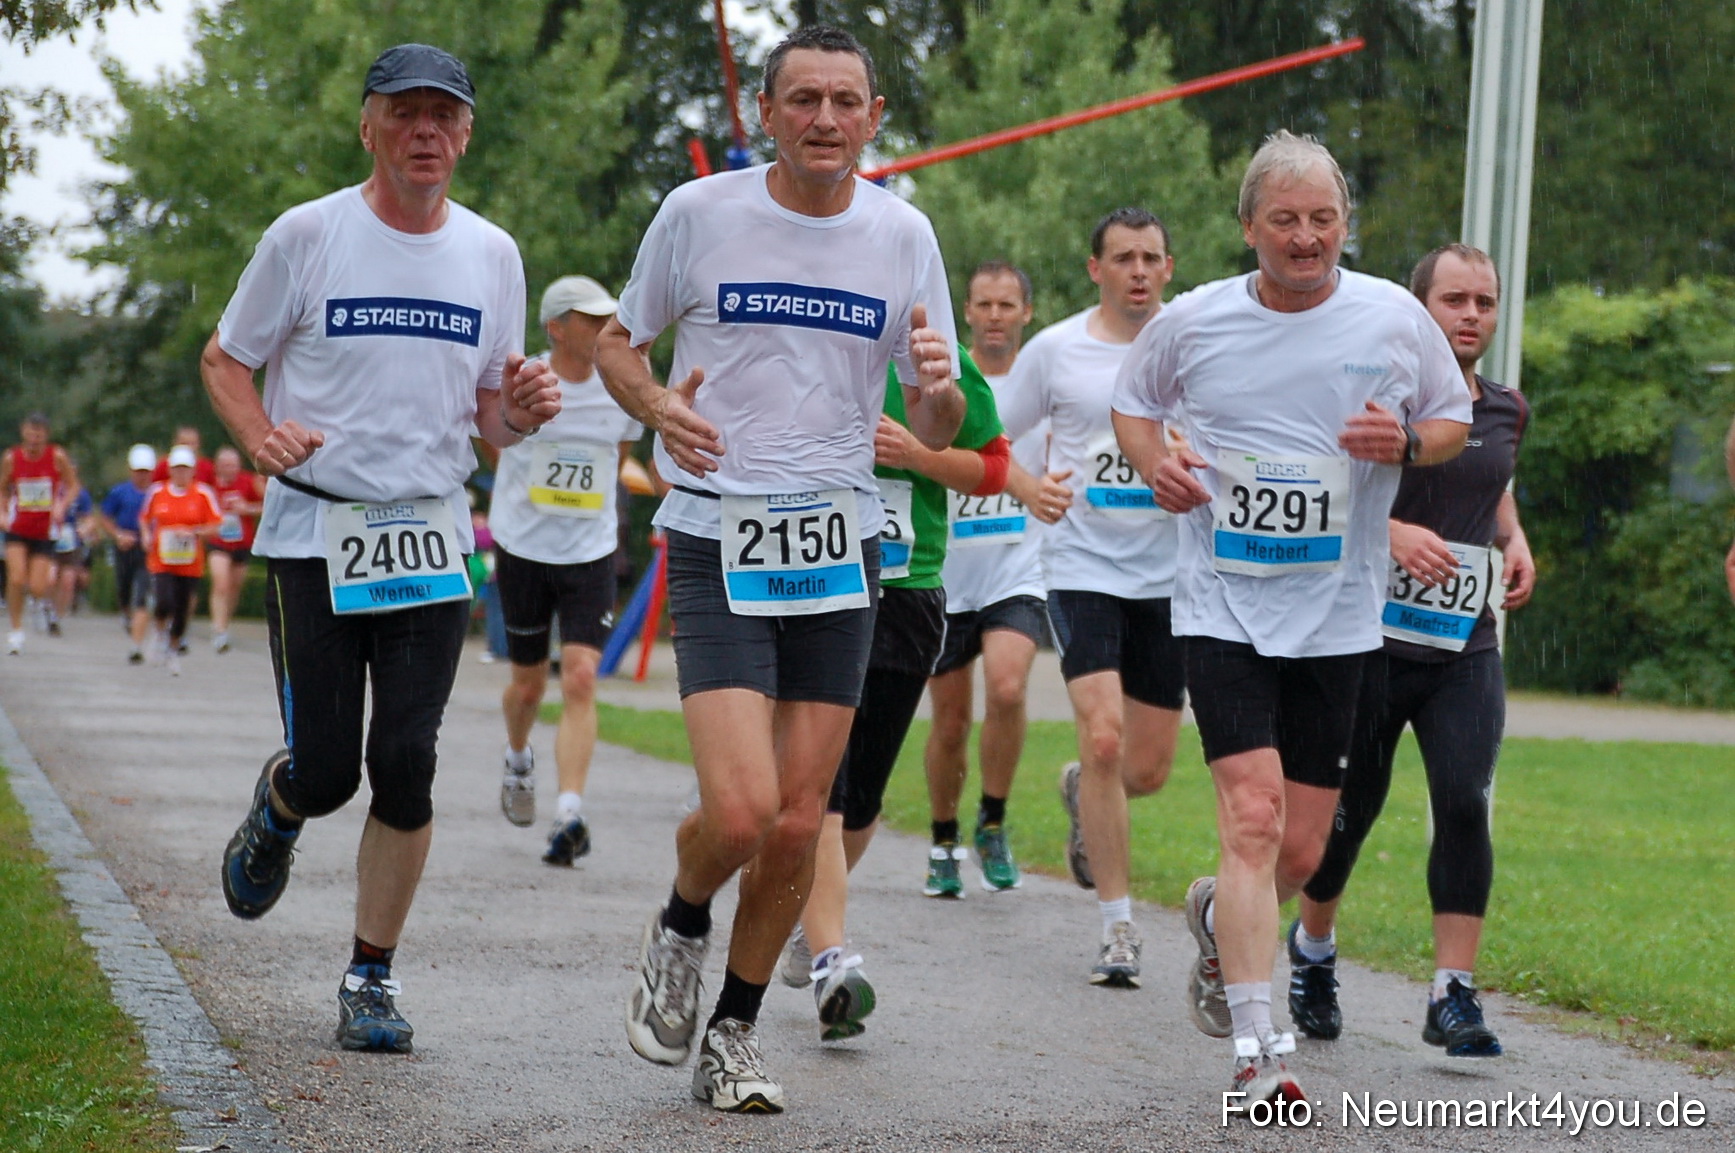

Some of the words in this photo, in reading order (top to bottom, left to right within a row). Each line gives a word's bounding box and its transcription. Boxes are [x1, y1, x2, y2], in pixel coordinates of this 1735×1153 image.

[353, 307, 472, 336] STAEDTLER
[746, 294, 876, 328] STAEDTLER
[546, 462, 593, 491] 278
[1096, 453, 1134, 484] 25
[1229, 485, 1330, 533] 3291
[738, 512, 847, 565] 2150
[1245, 540, 1309, 560] Herbert
[341, 530, 448, 580] 2400
[368, 584, 433, 603] Werner
[768, 575, 826, 596] Martin
[1393, 565, 1477, 613] 3292
[1400, 609, 1460, 635] Manfred
